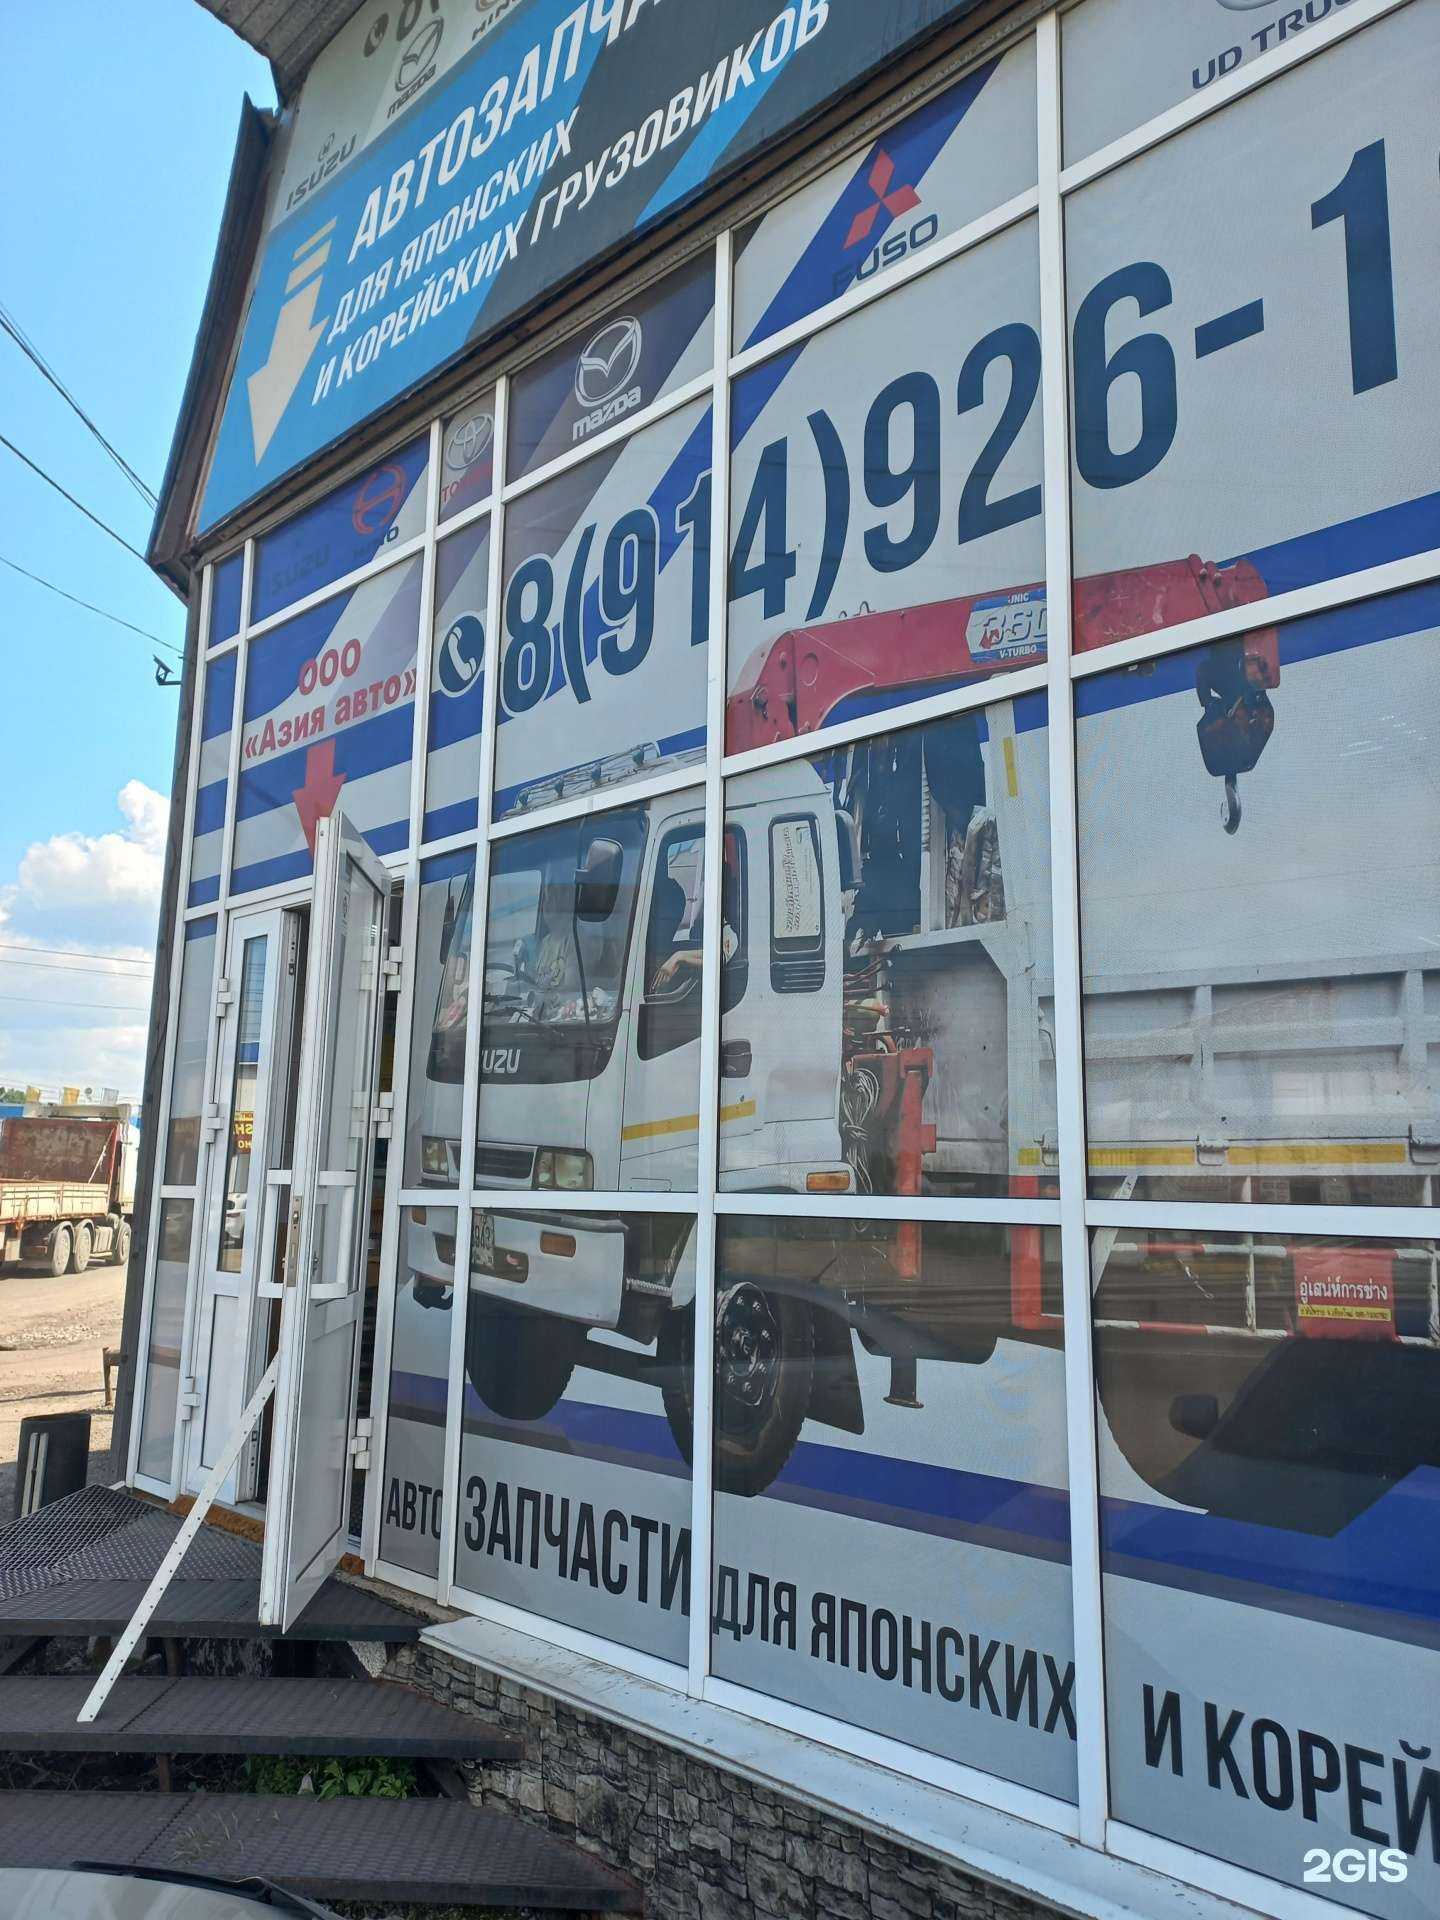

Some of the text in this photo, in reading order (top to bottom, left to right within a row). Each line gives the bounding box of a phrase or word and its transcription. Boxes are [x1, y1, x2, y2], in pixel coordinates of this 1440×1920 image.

[1192, 0, 1349, 89] UD TRU
[286, 133, 357, 211] ISUZU
[312, 0, 830, 406] И КОРЕЙСКИХ ГРУЗОВИКОВ
[327, 106, 580, 346] ДЛЯ ЯПОНСКИХ
[299, 638, 361, 696] ООО
[244, 668, 417, 759] «Азия авто»
[482, 1049, 521, 1074] UZU
[712, 1564, 797, 1651] ДЛЯ
[811, 1592, 1078, 1741] ЯПОНСКИХ
[1143, 1683, 1184, 1778] И
